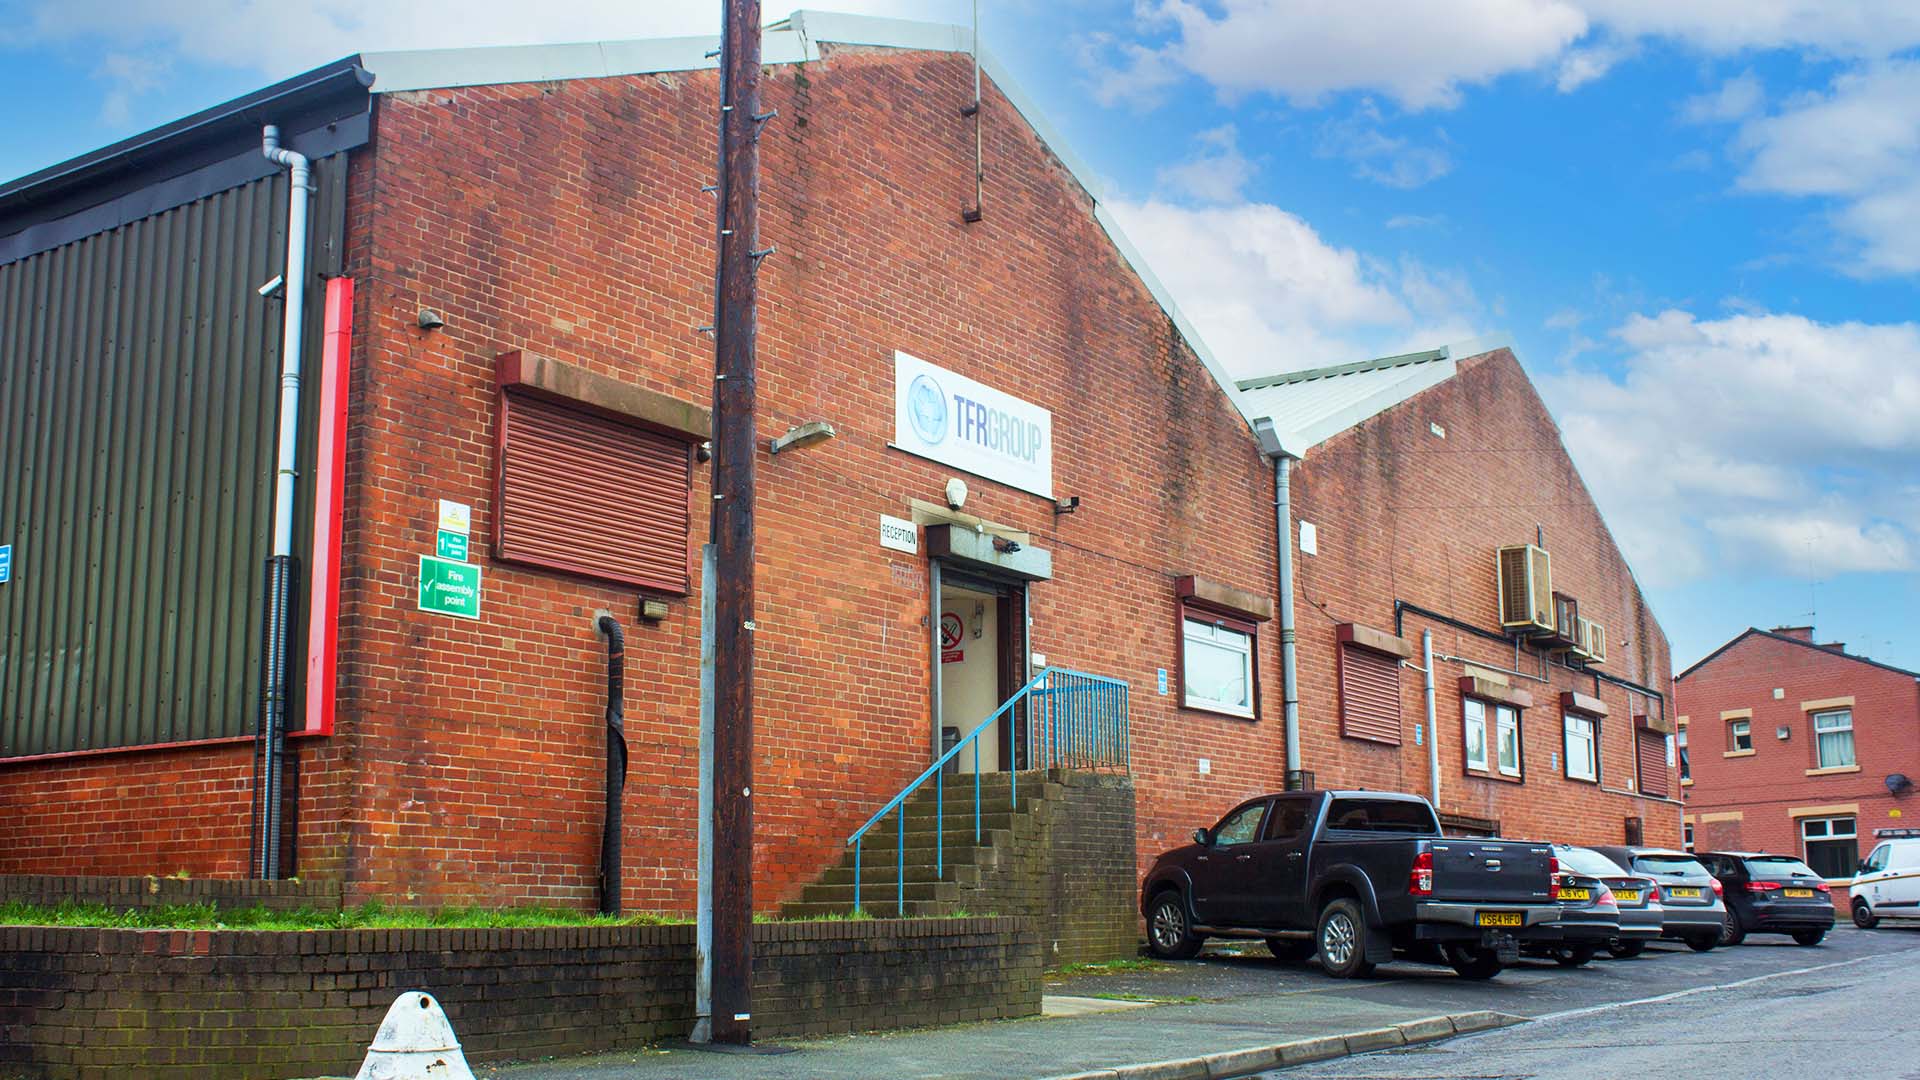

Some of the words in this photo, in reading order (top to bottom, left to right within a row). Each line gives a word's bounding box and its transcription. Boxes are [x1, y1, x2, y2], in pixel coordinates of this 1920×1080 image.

[882, 523, 916, 545] RECEPTION
[448, 569, 464, 582] Fire
[435, 582, 474, 598] assembly
[444, 595, 465, 607] point
[1480, 911, 1502, 924] YS64
[1503, 913, 1521, 925] HFO
